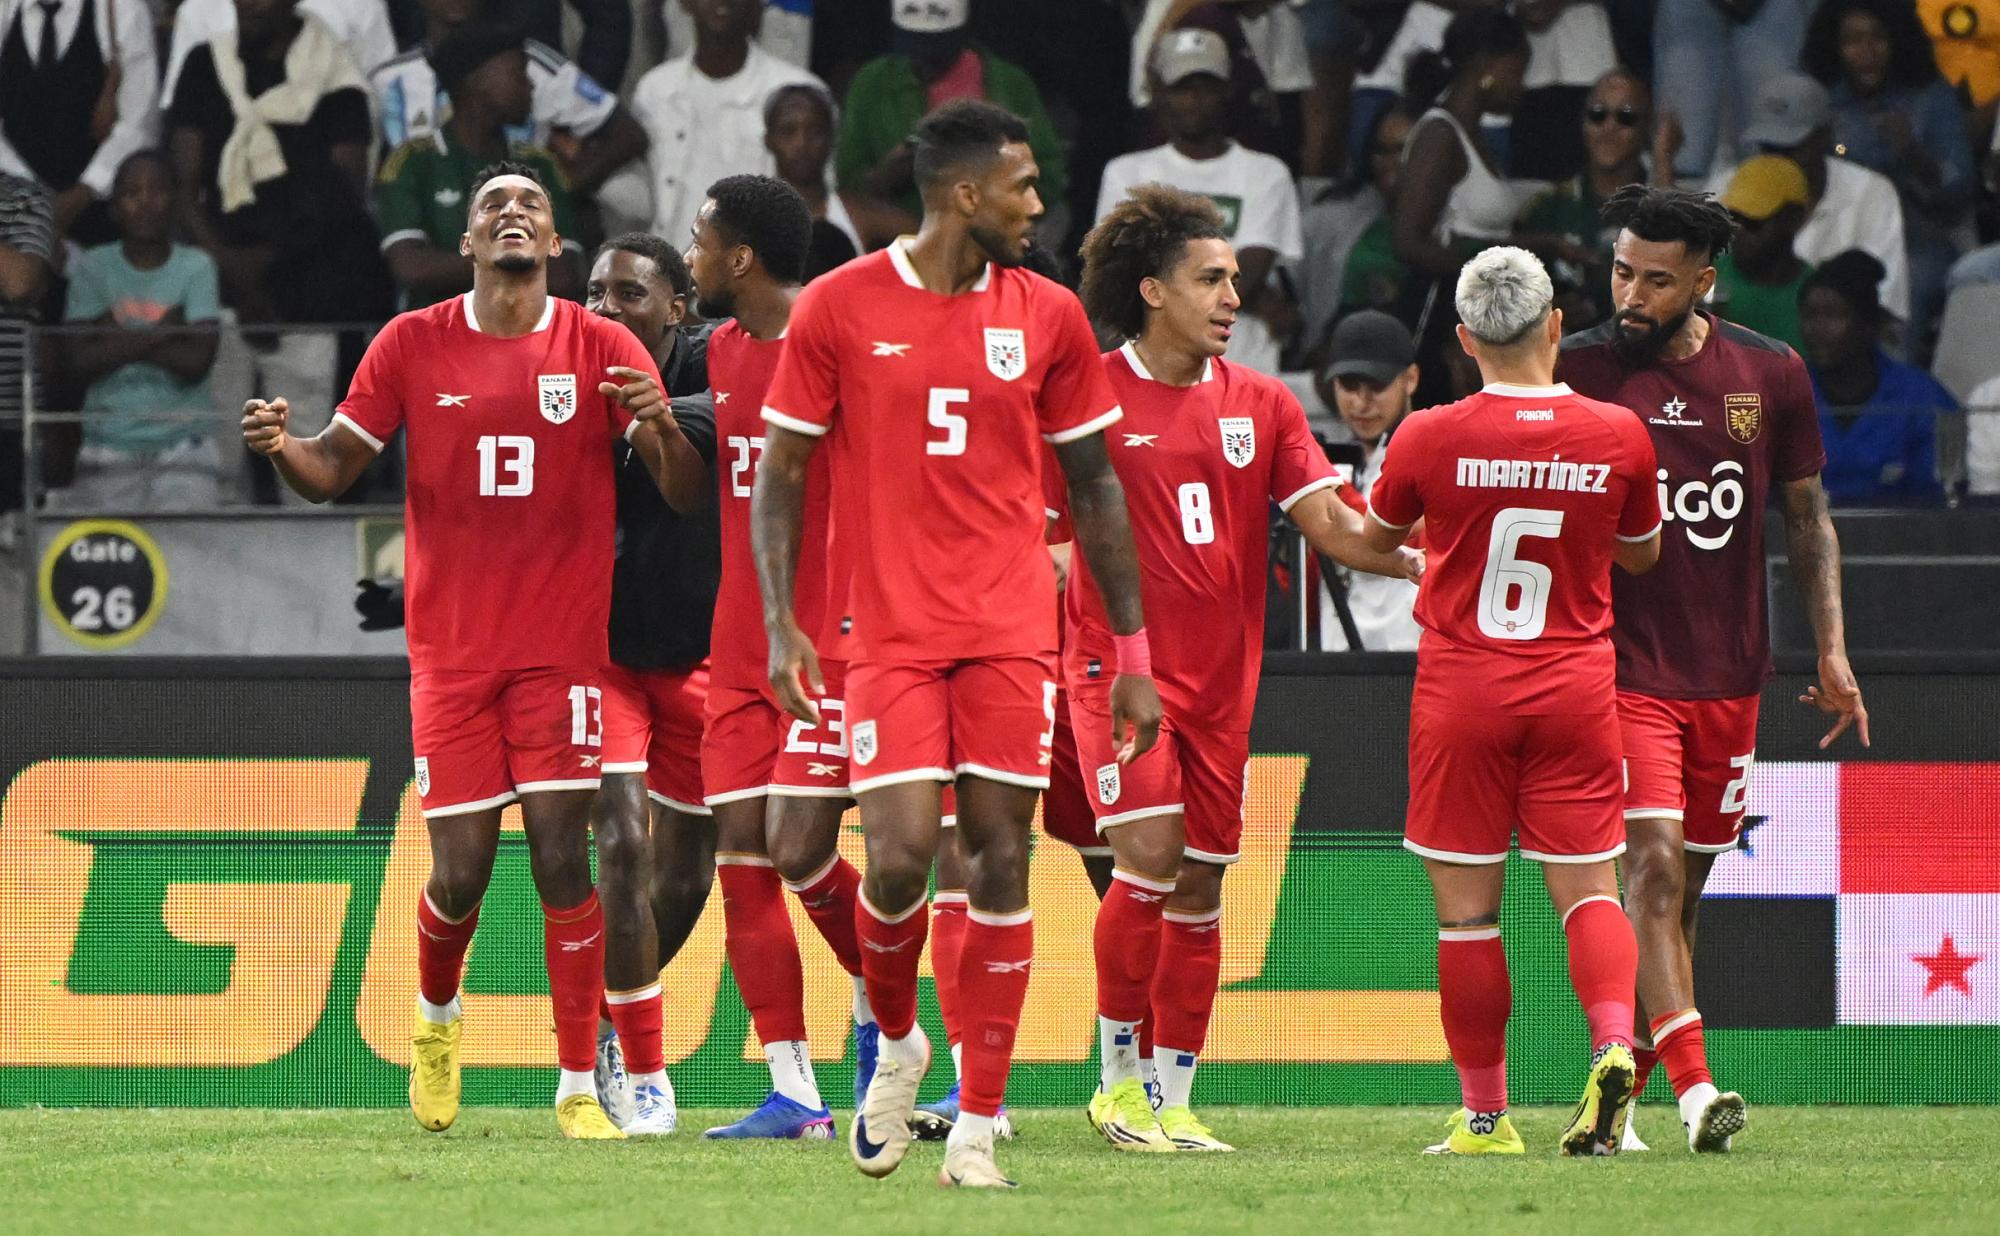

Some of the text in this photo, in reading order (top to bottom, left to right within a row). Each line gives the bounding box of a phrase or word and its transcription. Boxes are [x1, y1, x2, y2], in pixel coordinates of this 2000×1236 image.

[926, 387, 970, 456] 5
[1516, 408, 1554, 421] PANAMÁ
[476, 435, 535, 497] 13
[1456, 454, 1611, 493] MARTÍNEZ
[1178, 482, 1215, 545] 8
[70, 538, 136, 562] Gate
[1477, 507, 1565, 640] 6
[71, 586, 136, 630] 26
[567, 685, 604, 747] 13
[783, 698, 849, 758] 23
